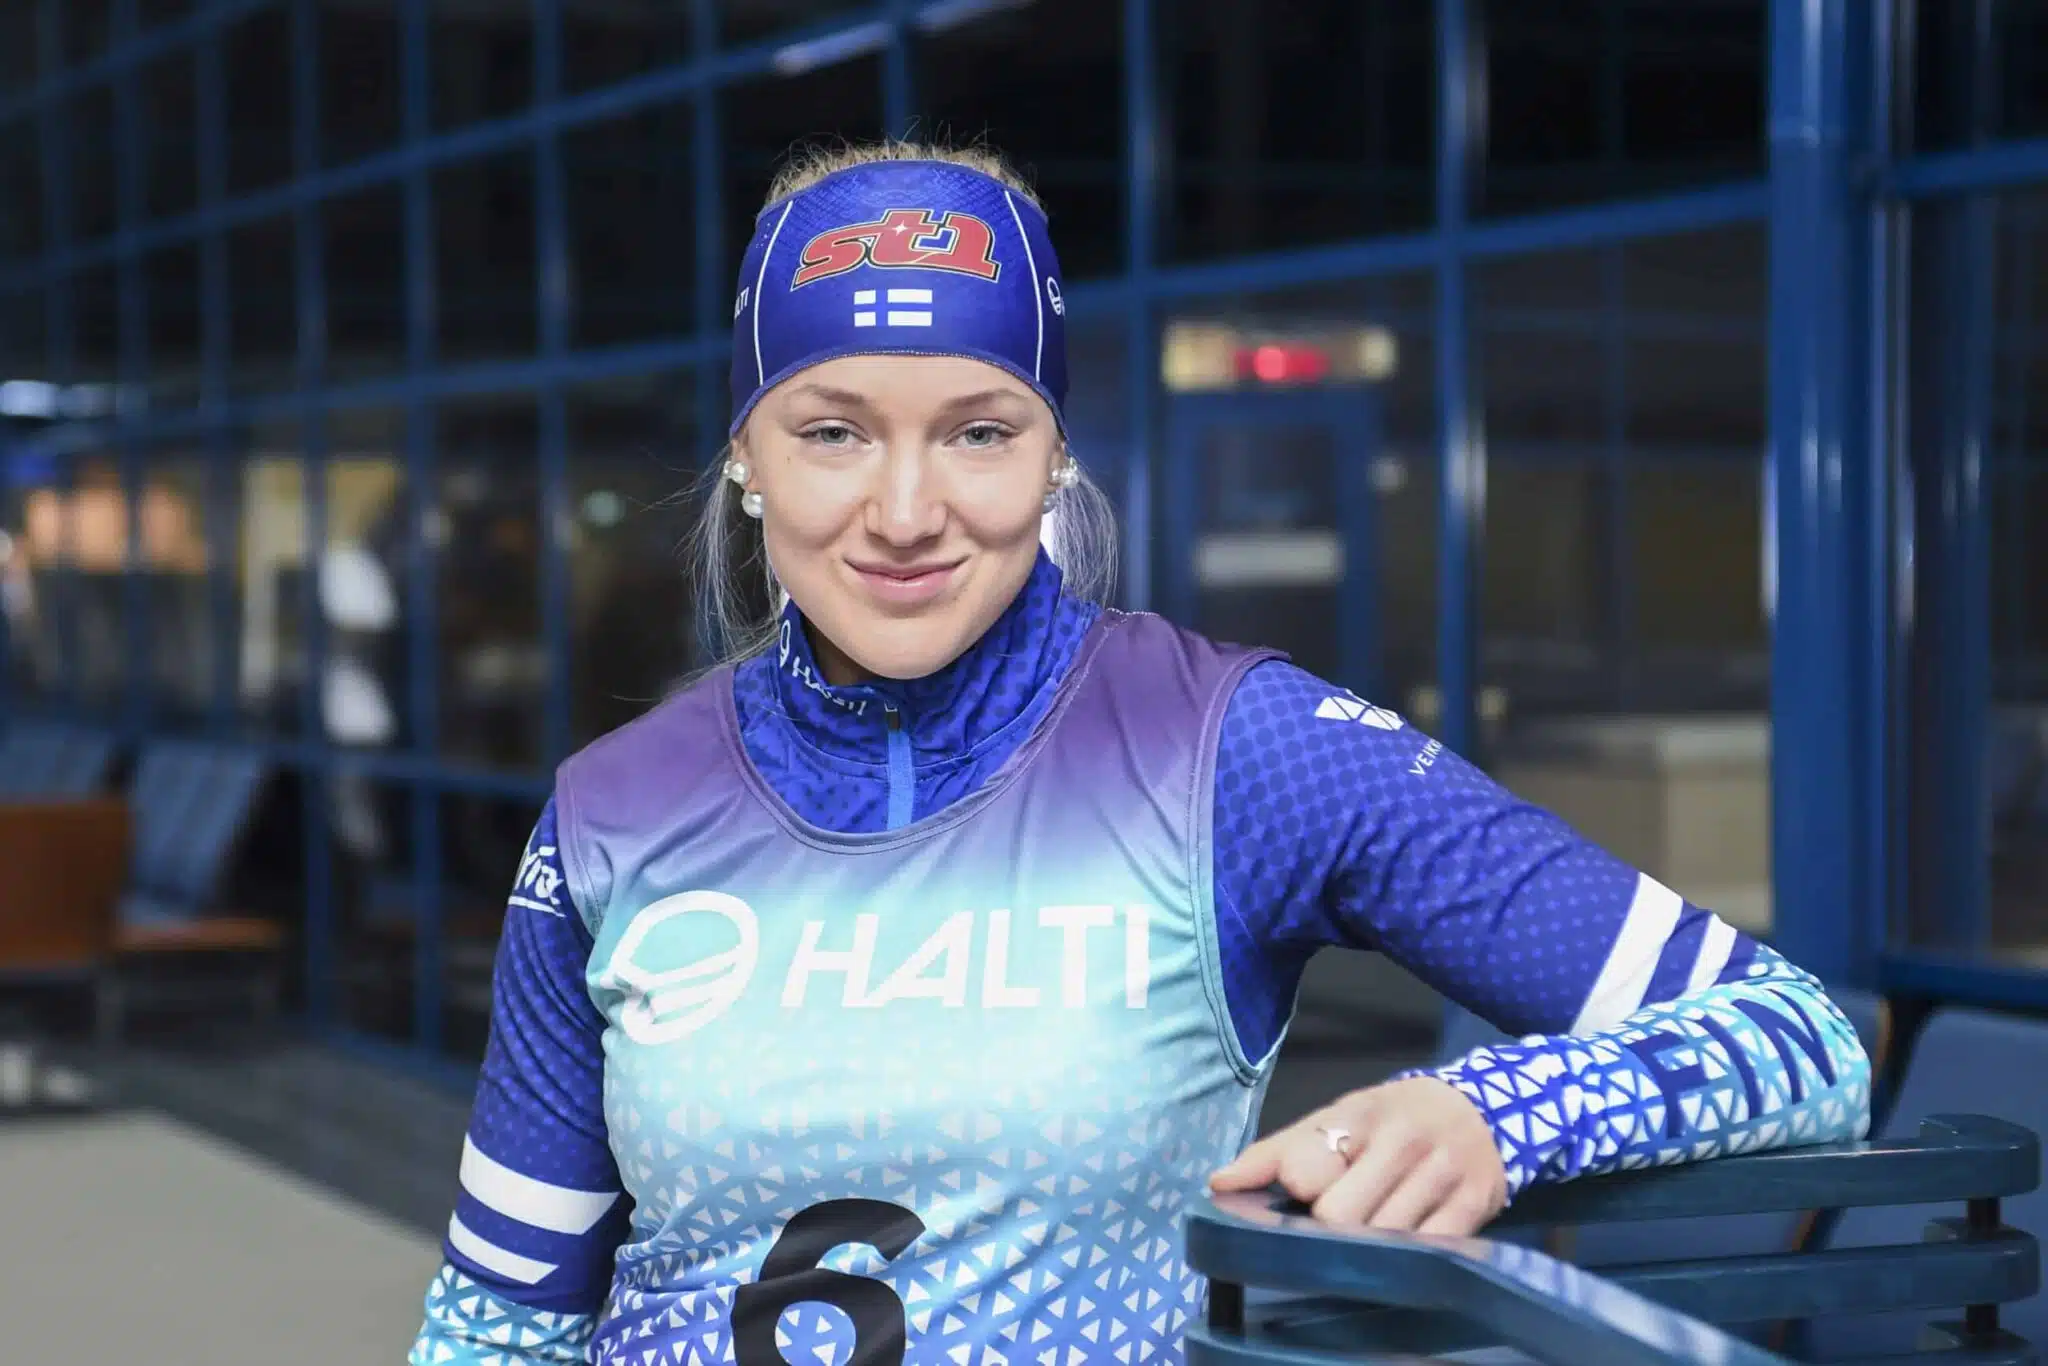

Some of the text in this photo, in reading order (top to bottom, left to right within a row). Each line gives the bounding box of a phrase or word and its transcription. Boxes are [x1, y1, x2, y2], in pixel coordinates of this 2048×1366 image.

[779, 903, 1151, 1009] HALTI
[1624, 987, 1838, 1140] FIN
[730, 1197, 927, 1366] 6
